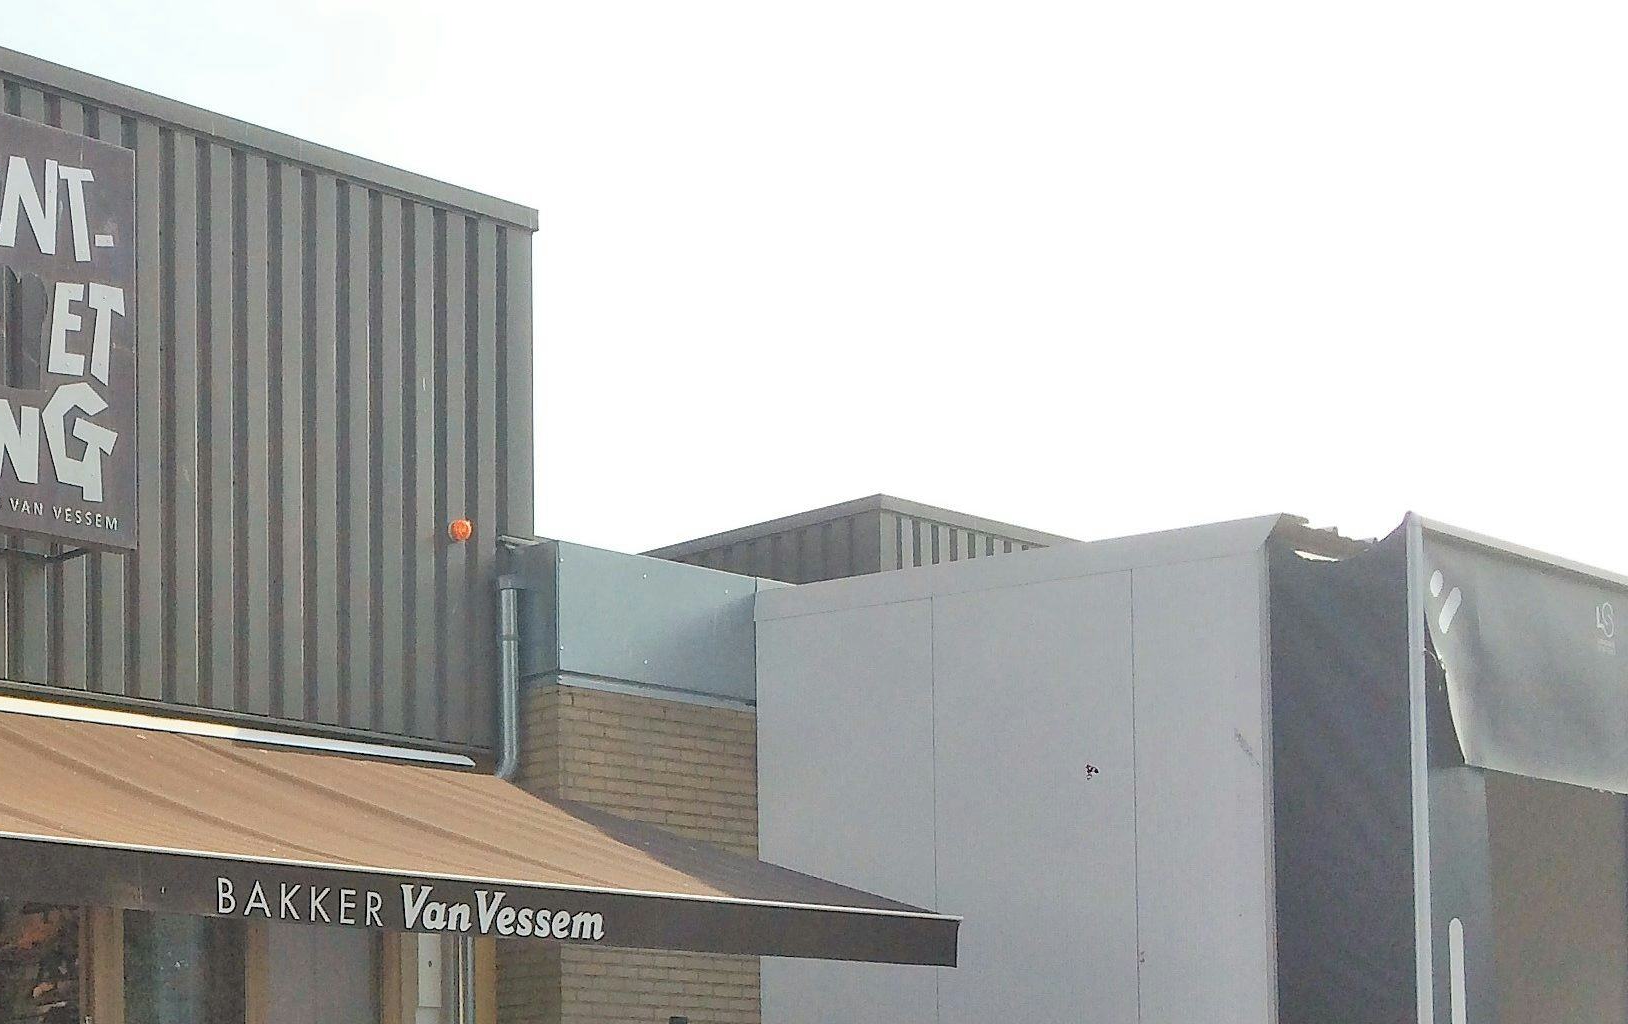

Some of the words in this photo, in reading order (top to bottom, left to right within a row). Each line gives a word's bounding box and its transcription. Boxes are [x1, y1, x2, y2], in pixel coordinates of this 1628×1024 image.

[9, 497, 44, 516] VAN
[52, 506, 119, 531] VESSEM
[218, 877, 384, 927] BAKKER
